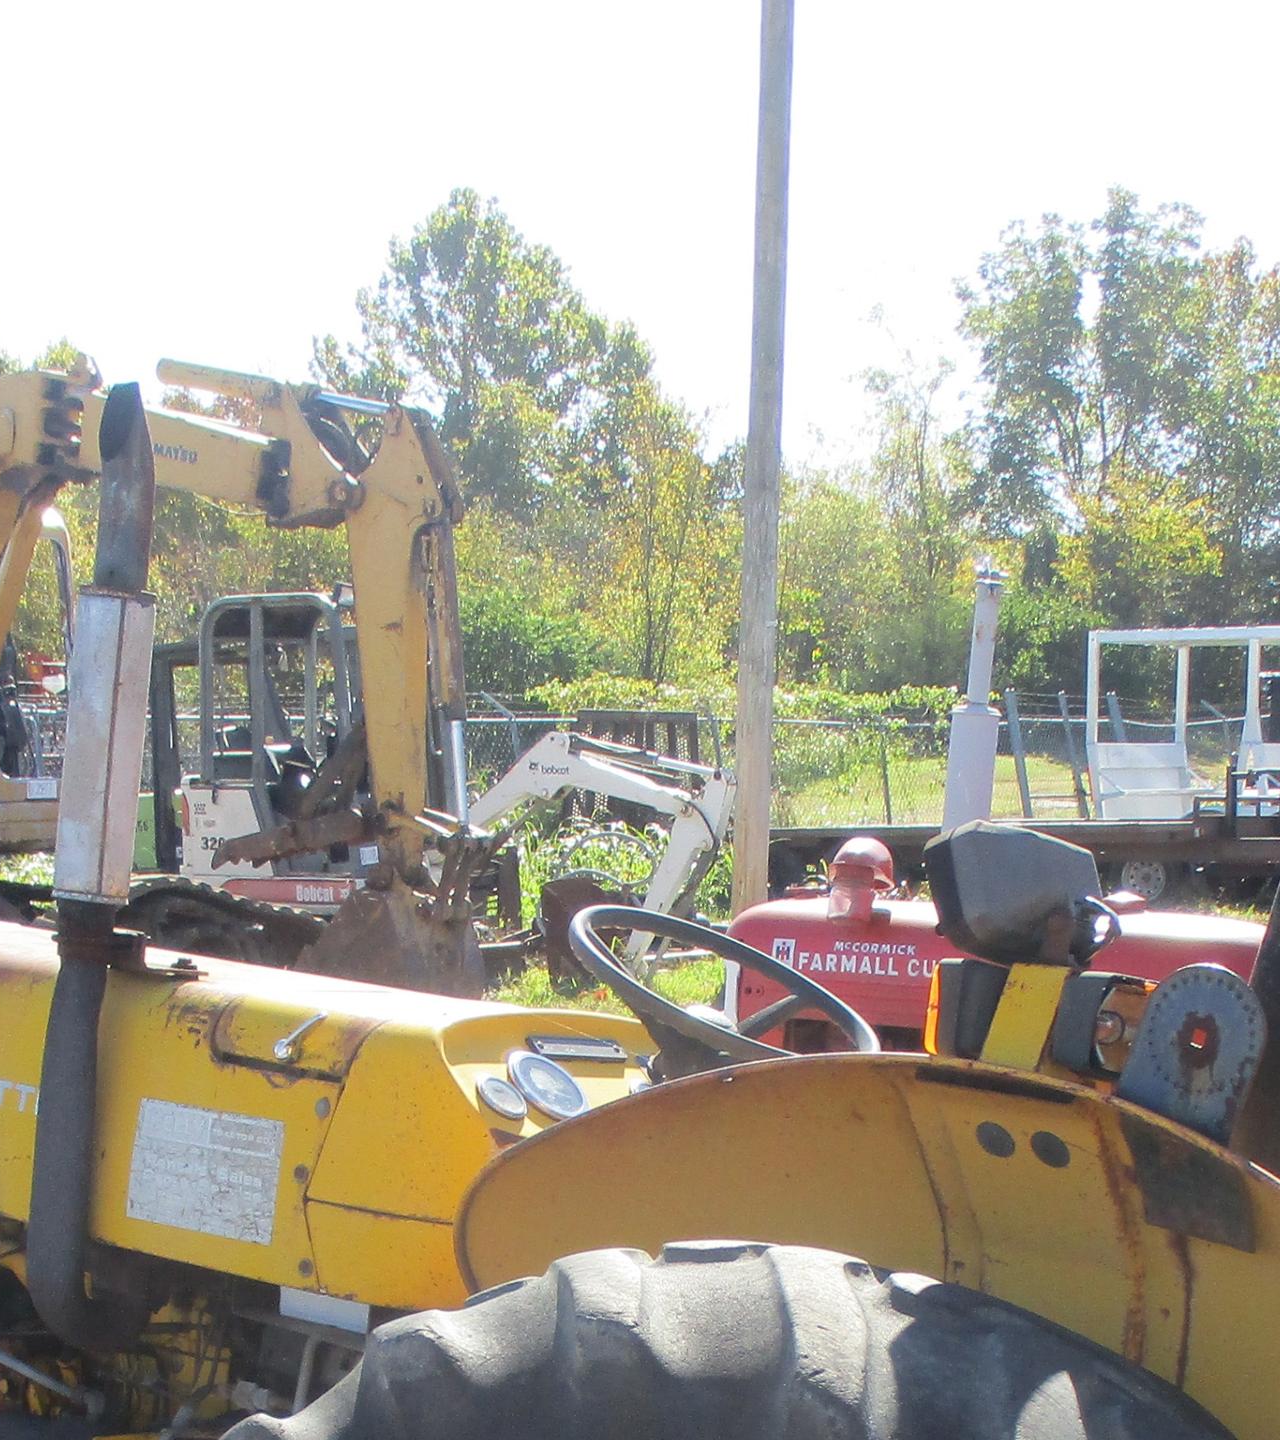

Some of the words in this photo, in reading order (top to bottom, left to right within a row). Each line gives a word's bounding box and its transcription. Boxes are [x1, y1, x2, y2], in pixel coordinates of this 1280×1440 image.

[153, 442, 199, 465] MATSU
[296, 885, 334, 902] Bobcat
[798, 952, 899, 977] FARMALL
[907, 958, 936, 978] CU
